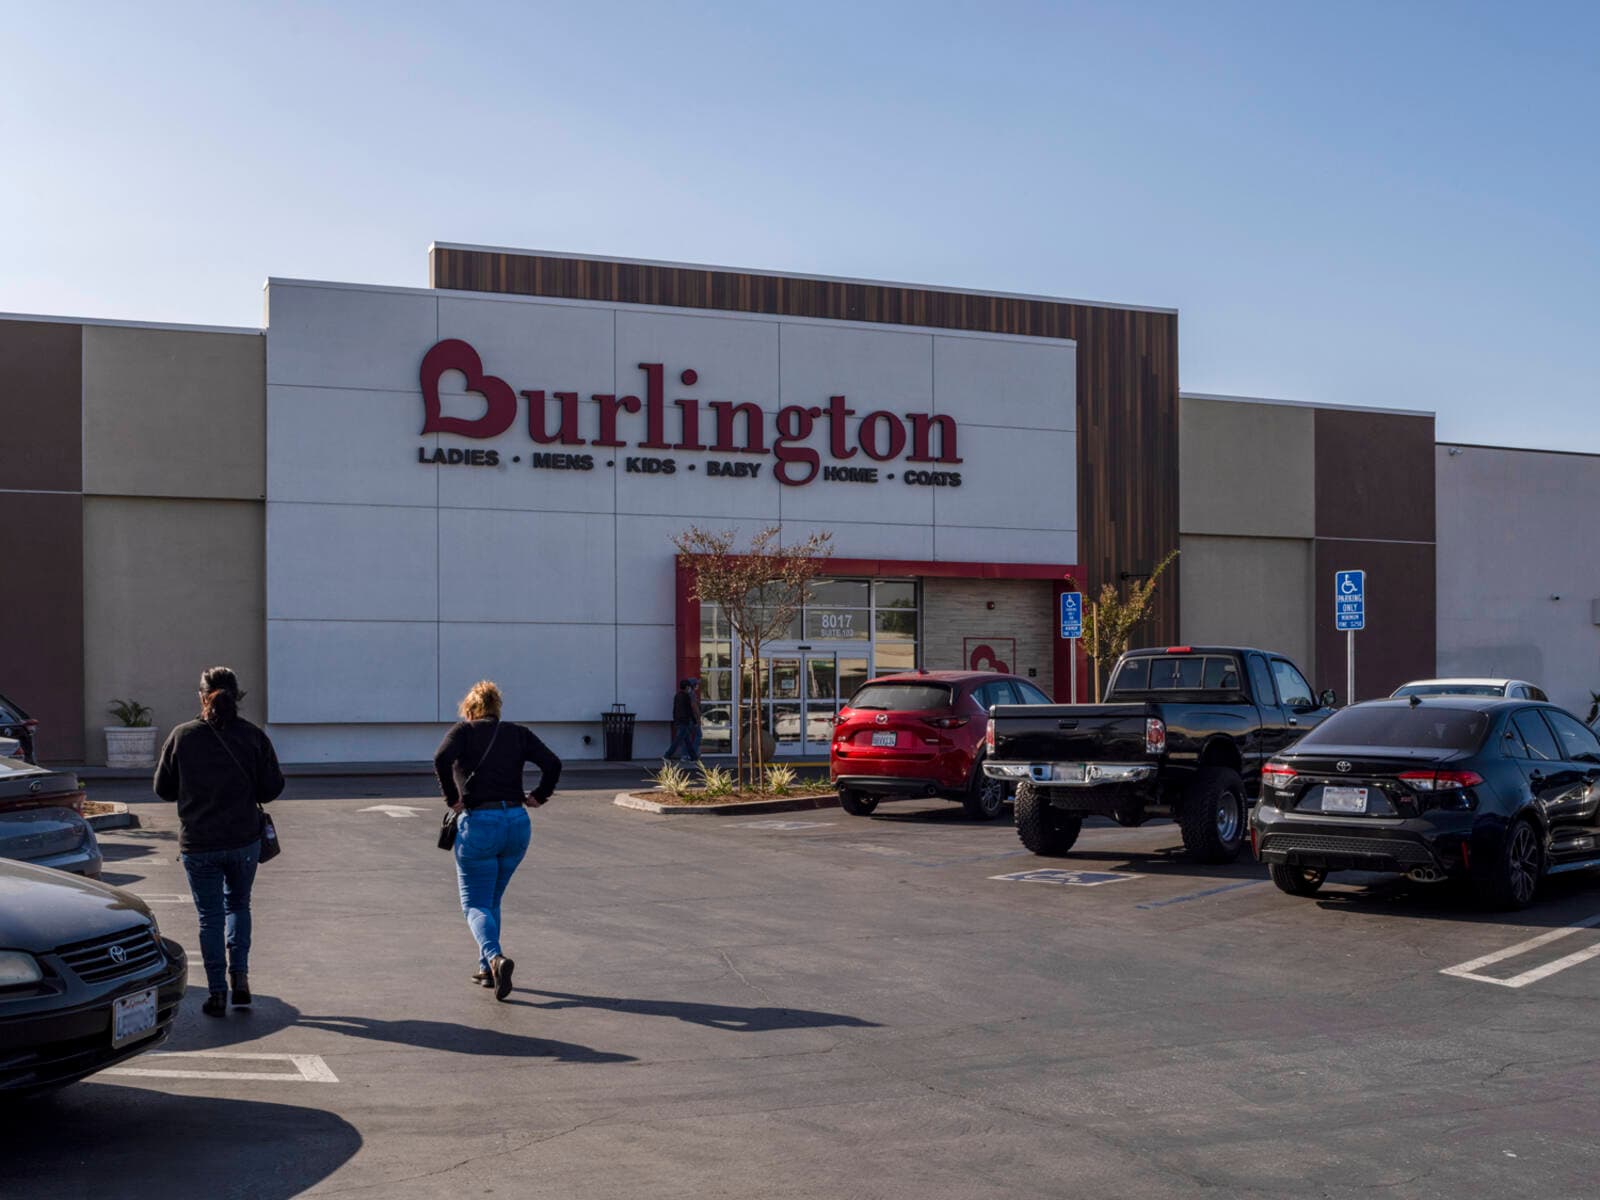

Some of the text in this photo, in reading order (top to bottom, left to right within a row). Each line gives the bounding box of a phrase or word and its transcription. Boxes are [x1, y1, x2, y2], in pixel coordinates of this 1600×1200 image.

[420, 338, 963, 486] Burlington
[418, 447, 962, 487] LADIES MENS KIDS BABY HOME COATS
[1338, 594, 1362, 603] PARKING
[822, 614, 852, 629] 8017
[821, 629, 841, 637] SUITE
